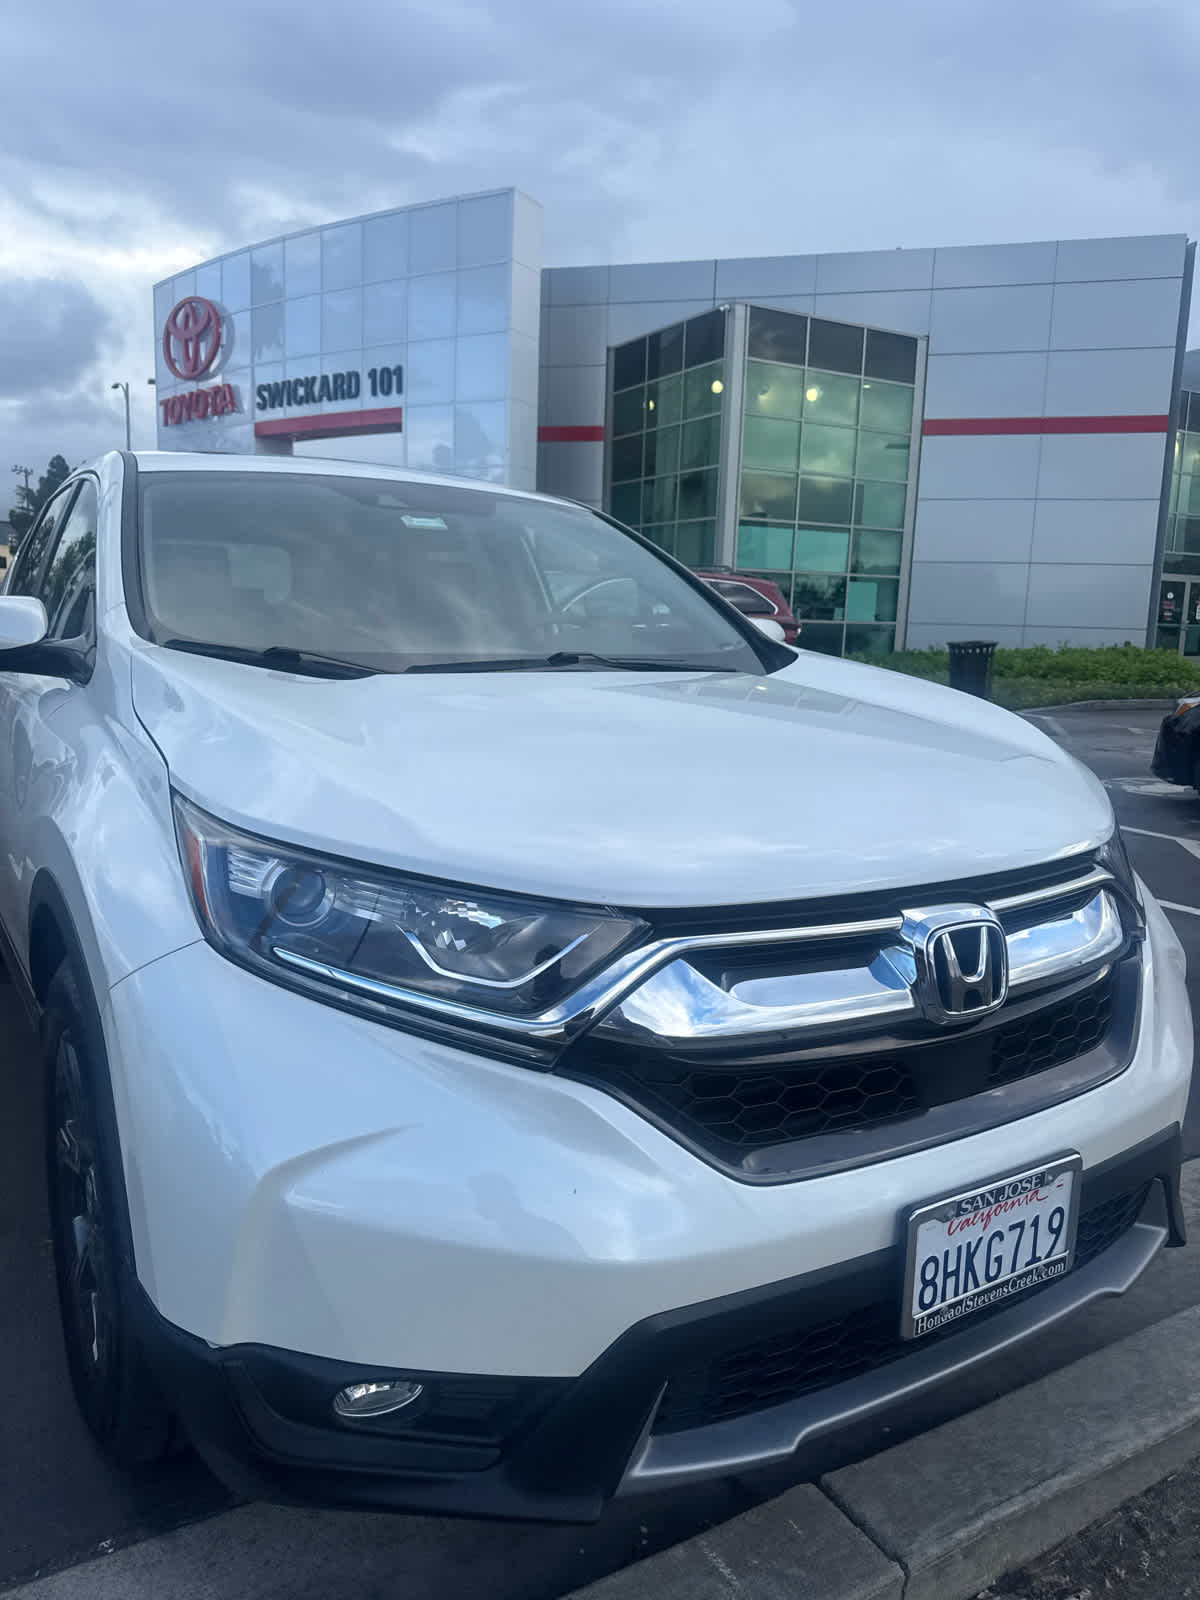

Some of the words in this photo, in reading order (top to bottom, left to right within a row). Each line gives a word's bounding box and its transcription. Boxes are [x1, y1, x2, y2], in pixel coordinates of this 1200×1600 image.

[160, 384, 235, 427] TOYOTA
[256, 371, 360, 411] SWICKARD
[367, 365, 404, 397] 101
[947, 1189, 1048, 1236] California
[960, 1191, 996, 1214] SAN
[1000, 1174, 1041, 1199] JOSE
[918, 1206, 1065, 1311] 8HKG719
